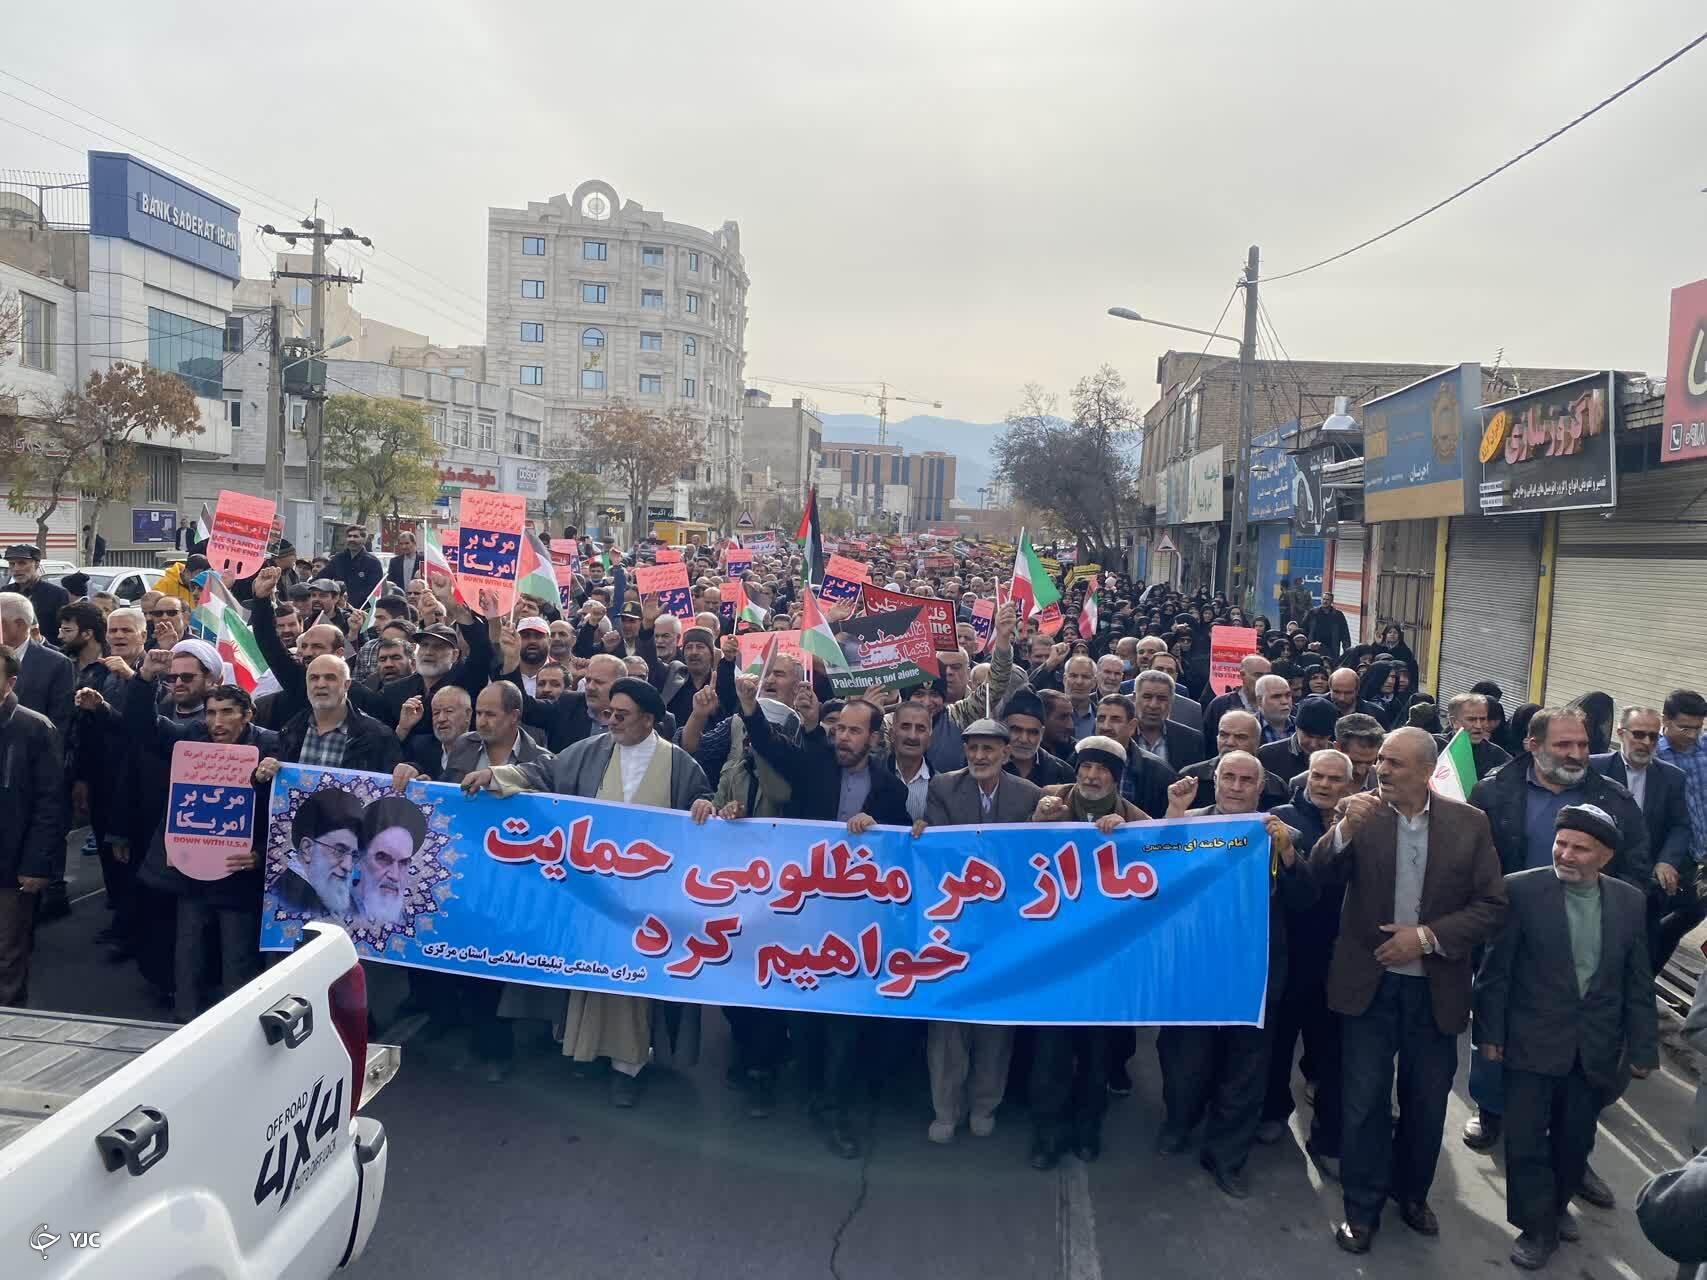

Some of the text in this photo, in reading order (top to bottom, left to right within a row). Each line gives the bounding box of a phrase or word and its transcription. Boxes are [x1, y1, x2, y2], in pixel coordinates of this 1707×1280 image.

[142, 192, 237, 250] BANK SADERAT IRAN
[214, 543, 260, 558] TO THE END
[464, 533, 515, 554] مرگ بر
[463, 552, 516, 577] امریکا
[858, 620, 927, 657] فلسطین
[861, 641, 931, 669] تنها نیست
[831, 668, 920, 689] Palestine is not alone
[178, 788, 245, 810] مرگ بر
[176, 810, 246, 836] امریکا
[173, 836, 248, 849] DOWN WITH U.S.A
[1184, 839, 1198, 852] ای
[1199, 838, 1225, 848] خامنه
[1227, 837, 1249, 849] امام
[485, 816, 1158, 920] ما از هر مظلومی حمایت
[423, 943, 648, 981] شورای هماهنگی تبلیغات اسلامی استان مرکزی
[633, 914, 969, 997] خواهیم کرد
[266, 1091, 309, 1142] OFF ROAD
